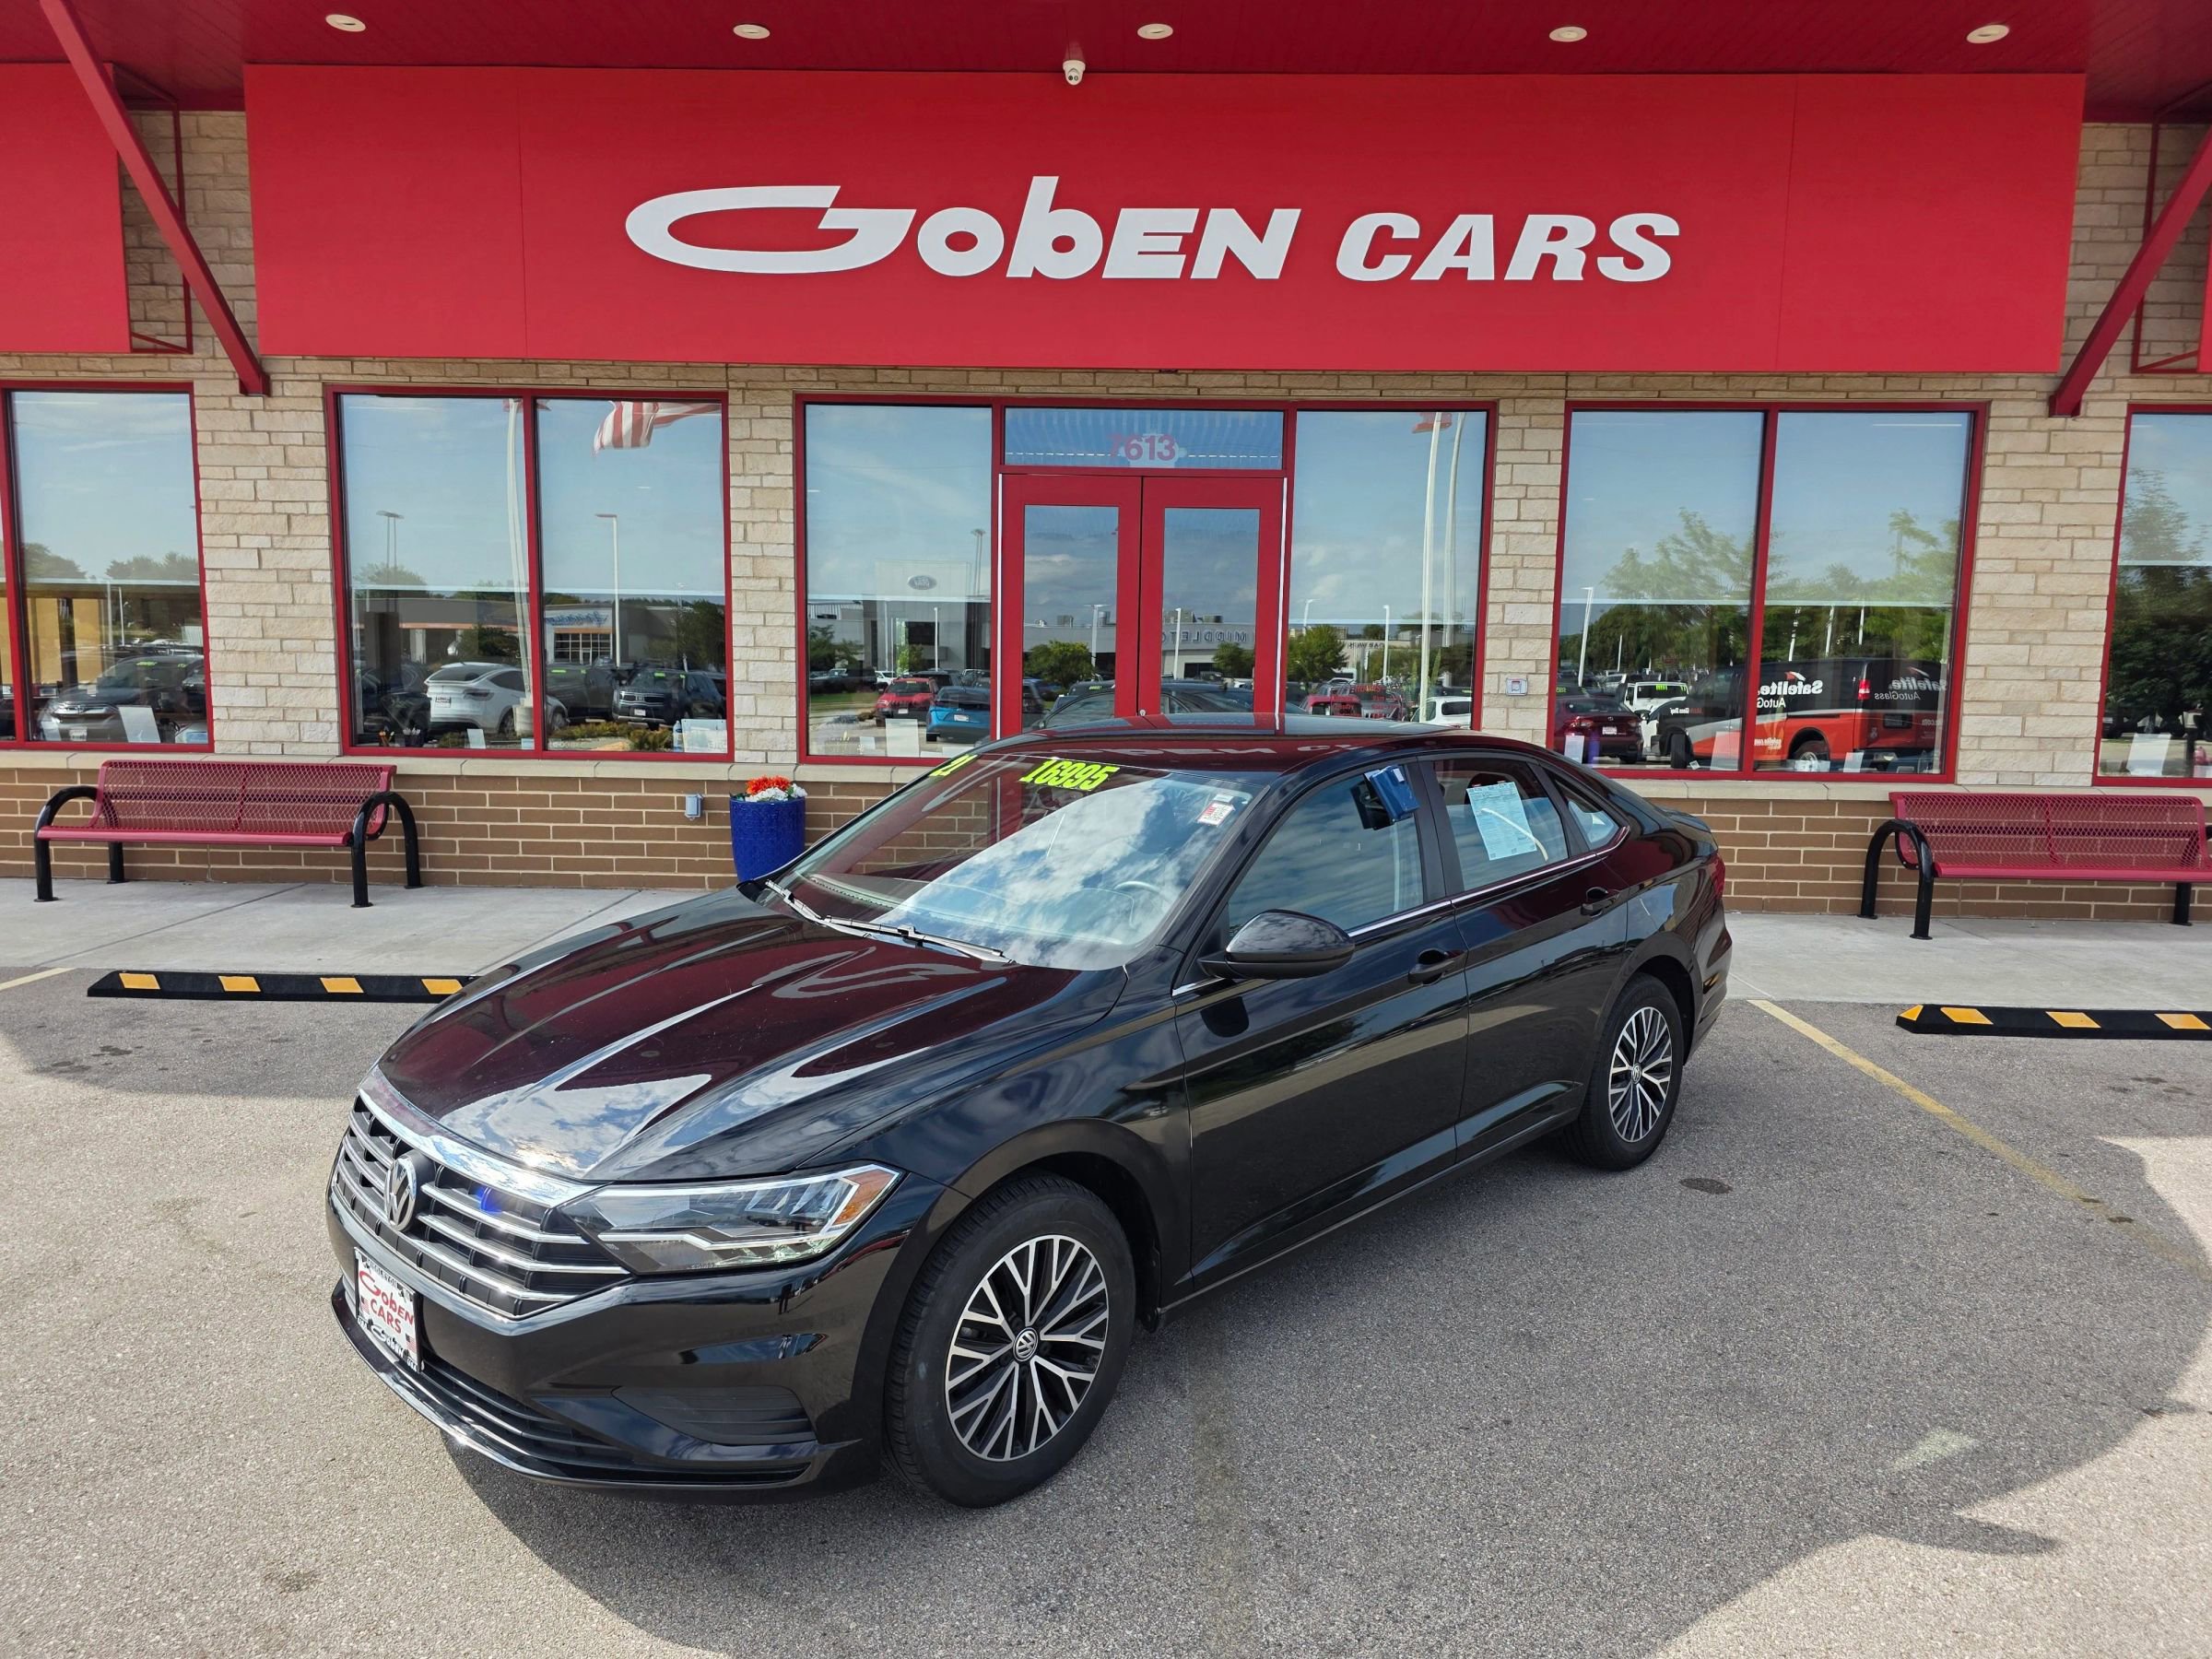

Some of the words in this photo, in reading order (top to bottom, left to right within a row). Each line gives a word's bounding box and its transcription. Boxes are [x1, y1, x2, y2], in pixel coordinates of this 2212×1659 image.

[1335, 212, 1680, 283] CARS
[1109, 433, 1176, 461] 7613
[1018, 759, 1121, 792] 16995
[371, 1299, 402, 1335] CARS
